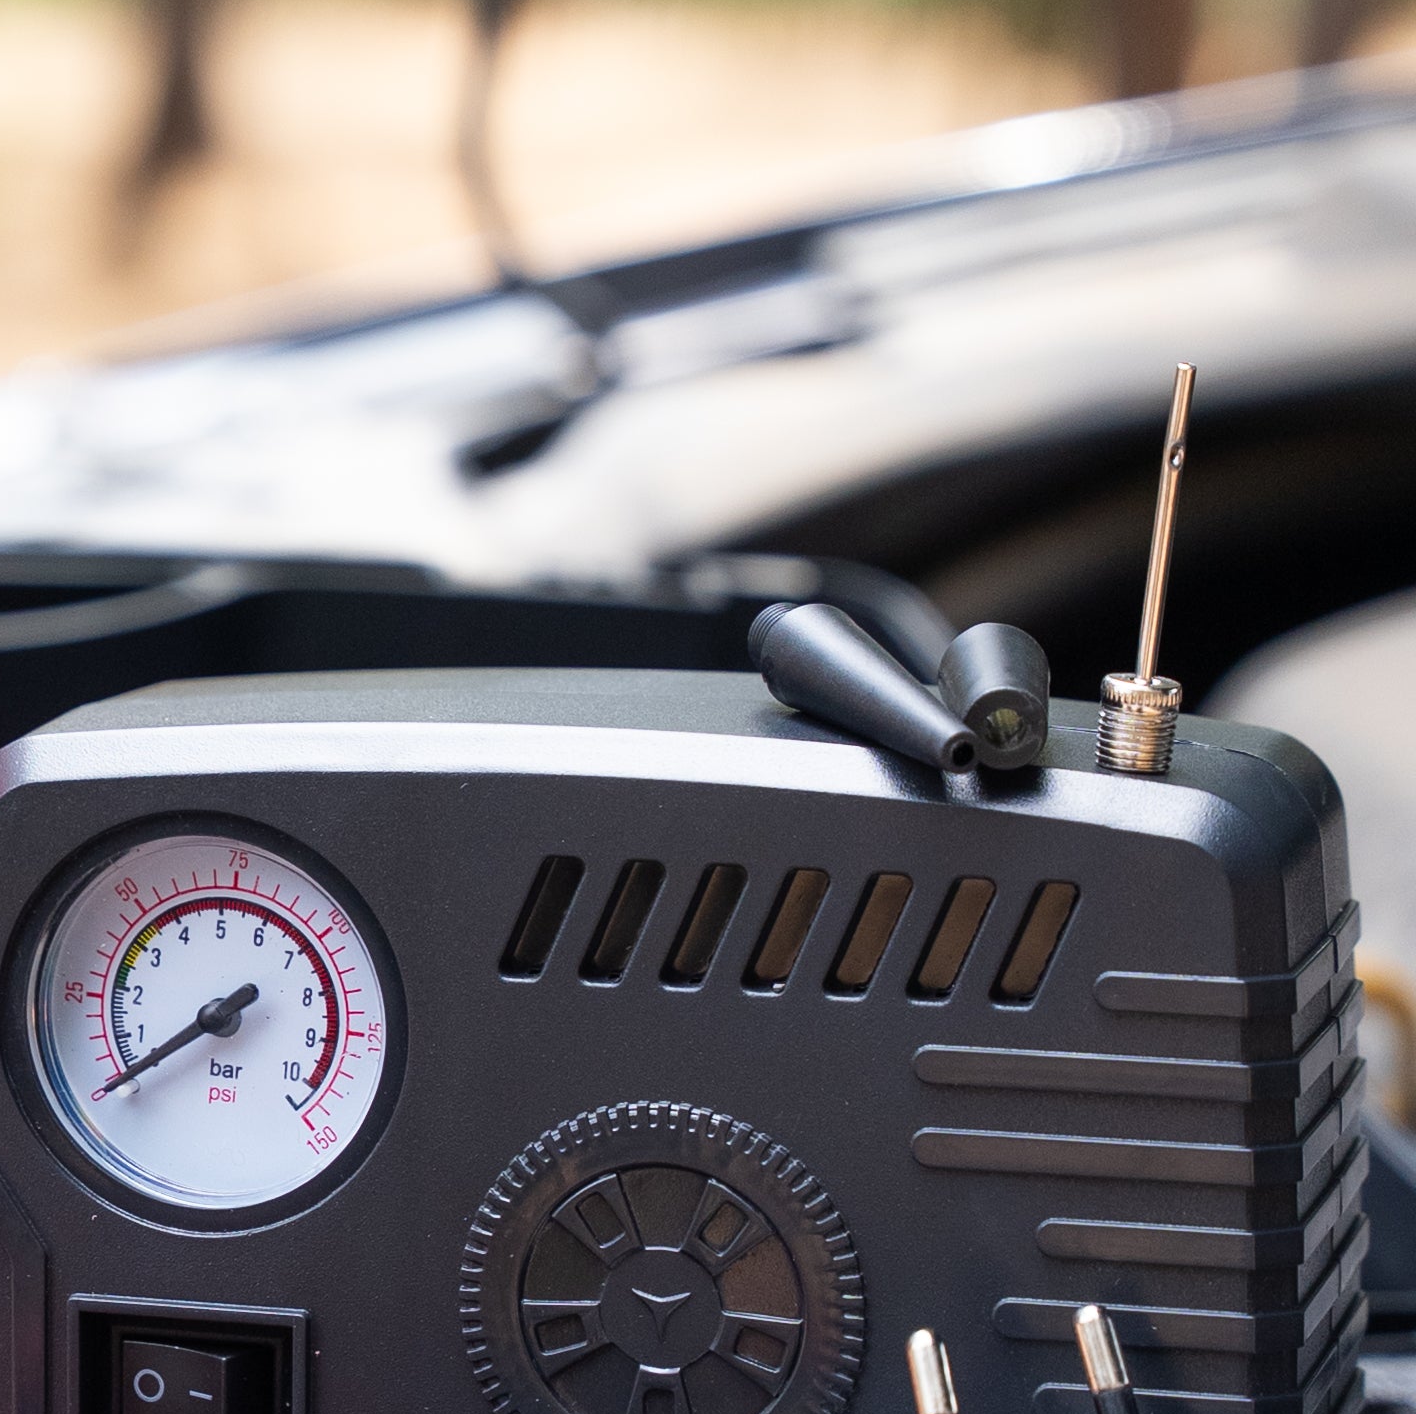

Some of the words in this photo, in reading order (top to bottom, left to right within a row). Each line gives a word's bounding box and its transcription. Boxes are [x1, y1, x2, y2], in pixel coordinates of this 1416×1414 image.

[228, 850, 249, 869] 75
[114, 877, 138, 902] 50
[178, 926, 190, 945] 4
[216, 920, 226, 939] 5
[253, 927, 264, 947] 6
[150, 948, 161, 968] 3
[284, 950, 294, 969] 7
[64, 981, 83, 1004] 25
[132, 985, 143, 1005] 2
[302, 988, 313, 1007] 8
[137, 1024, 144, 1043] 1
[305, 1028, 316, 1048] 9
[367, 1022, 383, 1053] 125
[210, 1058, 243, 1079] bar
[282, 1060, 300, 1081] 10
[208, 1086, 237, 1104] psi
[306, 1125, 338, 1155] 150
